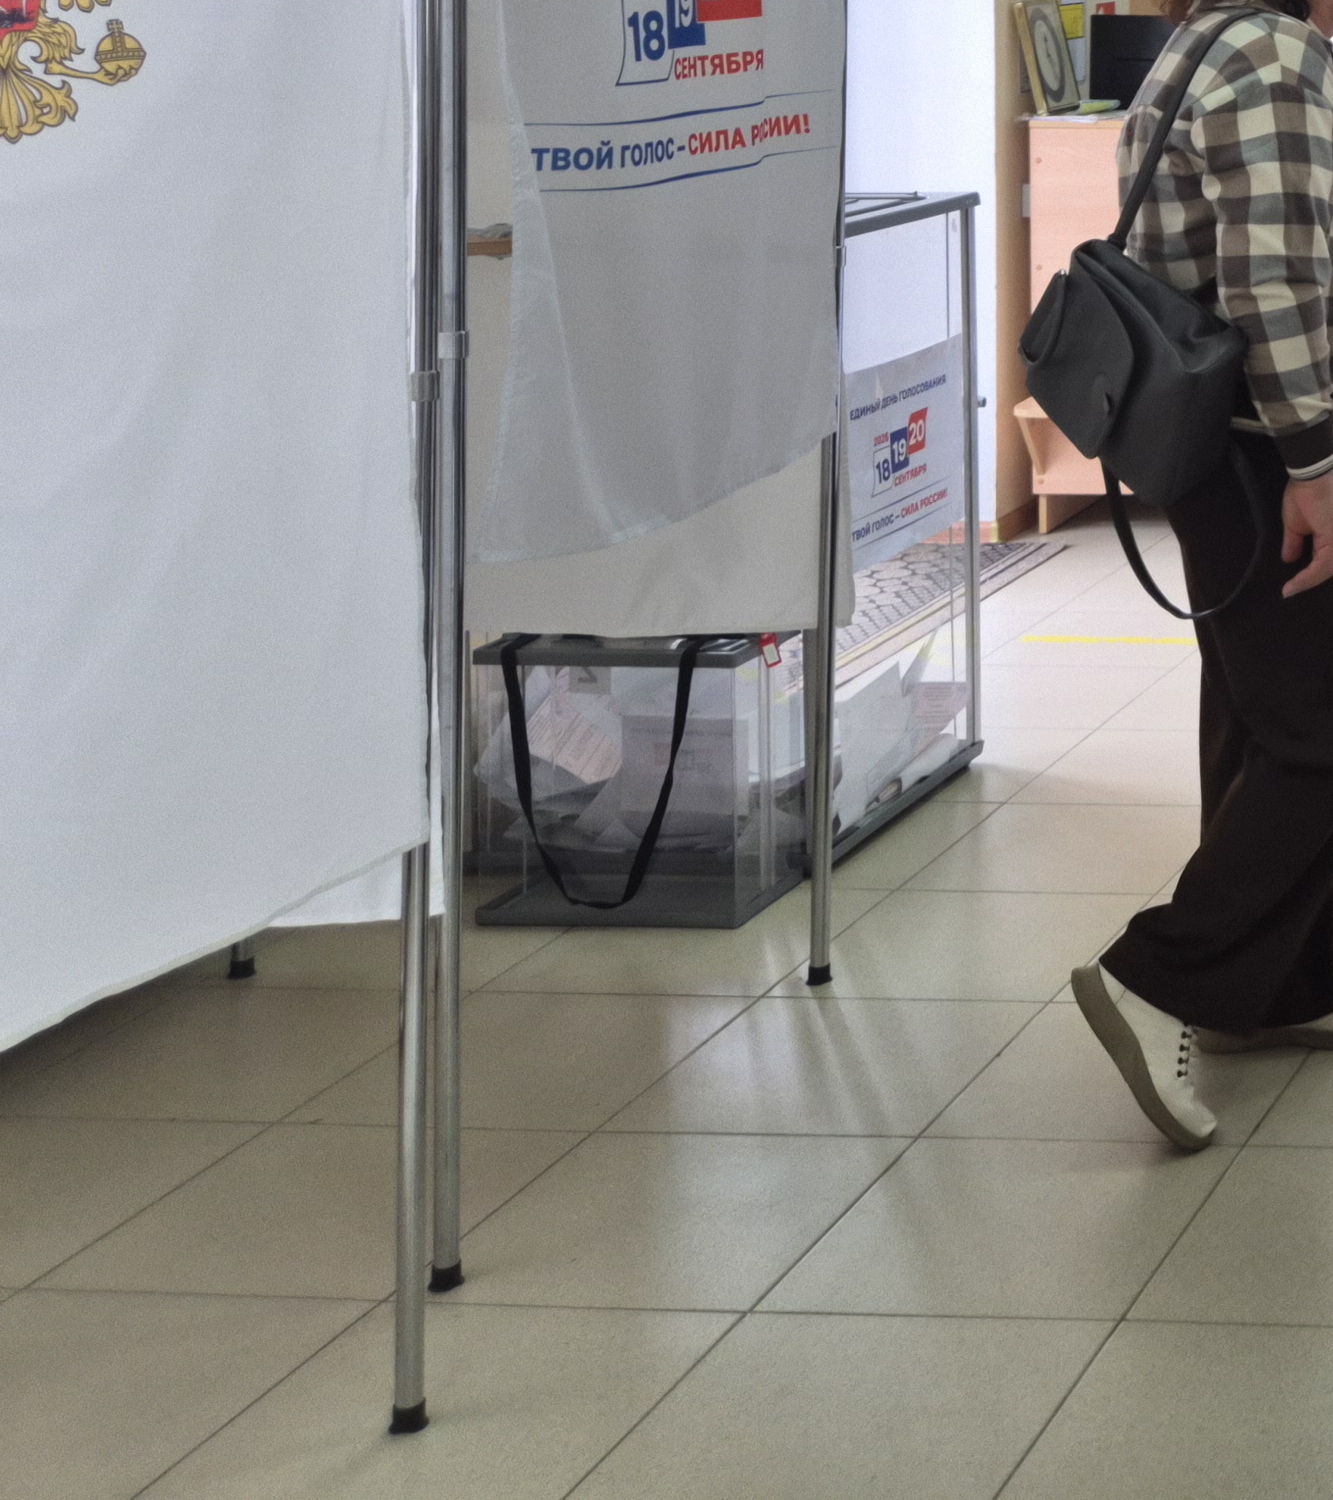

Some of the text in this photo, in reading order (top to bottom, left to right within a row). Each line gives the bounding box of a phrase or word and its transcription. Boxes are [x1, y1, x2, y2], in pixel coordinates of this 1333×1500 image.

[627, 10, 666, 63] 18
[674, 49, 764, 80] СЕНТЯБРЯ
[531, 140, 614, 171] ТВОЙ
[620, 137, 675, 168] ГОЛОС
[688, 127, 747, 155] СИЛА
[850, 374, 947, 421] ЕДИНЫЙ ДЕНЬ ГОЛОСОВАНИЯ
[873, 431, 889, 447] 2026
[909, 419, 925, 445] 20
[892, 439, 907, 464] 19
[875, 458, 891, 484] 18
[894, 463, 927, 487] СЕНТЯБРЯ
[852, 523, 871, 542] ТВОЙ
[871, 513, 894, 533] ГОЛОС
[901, 501, 920, 519] СИЛА
[920, 488, 948, 511] РОССИИ!
